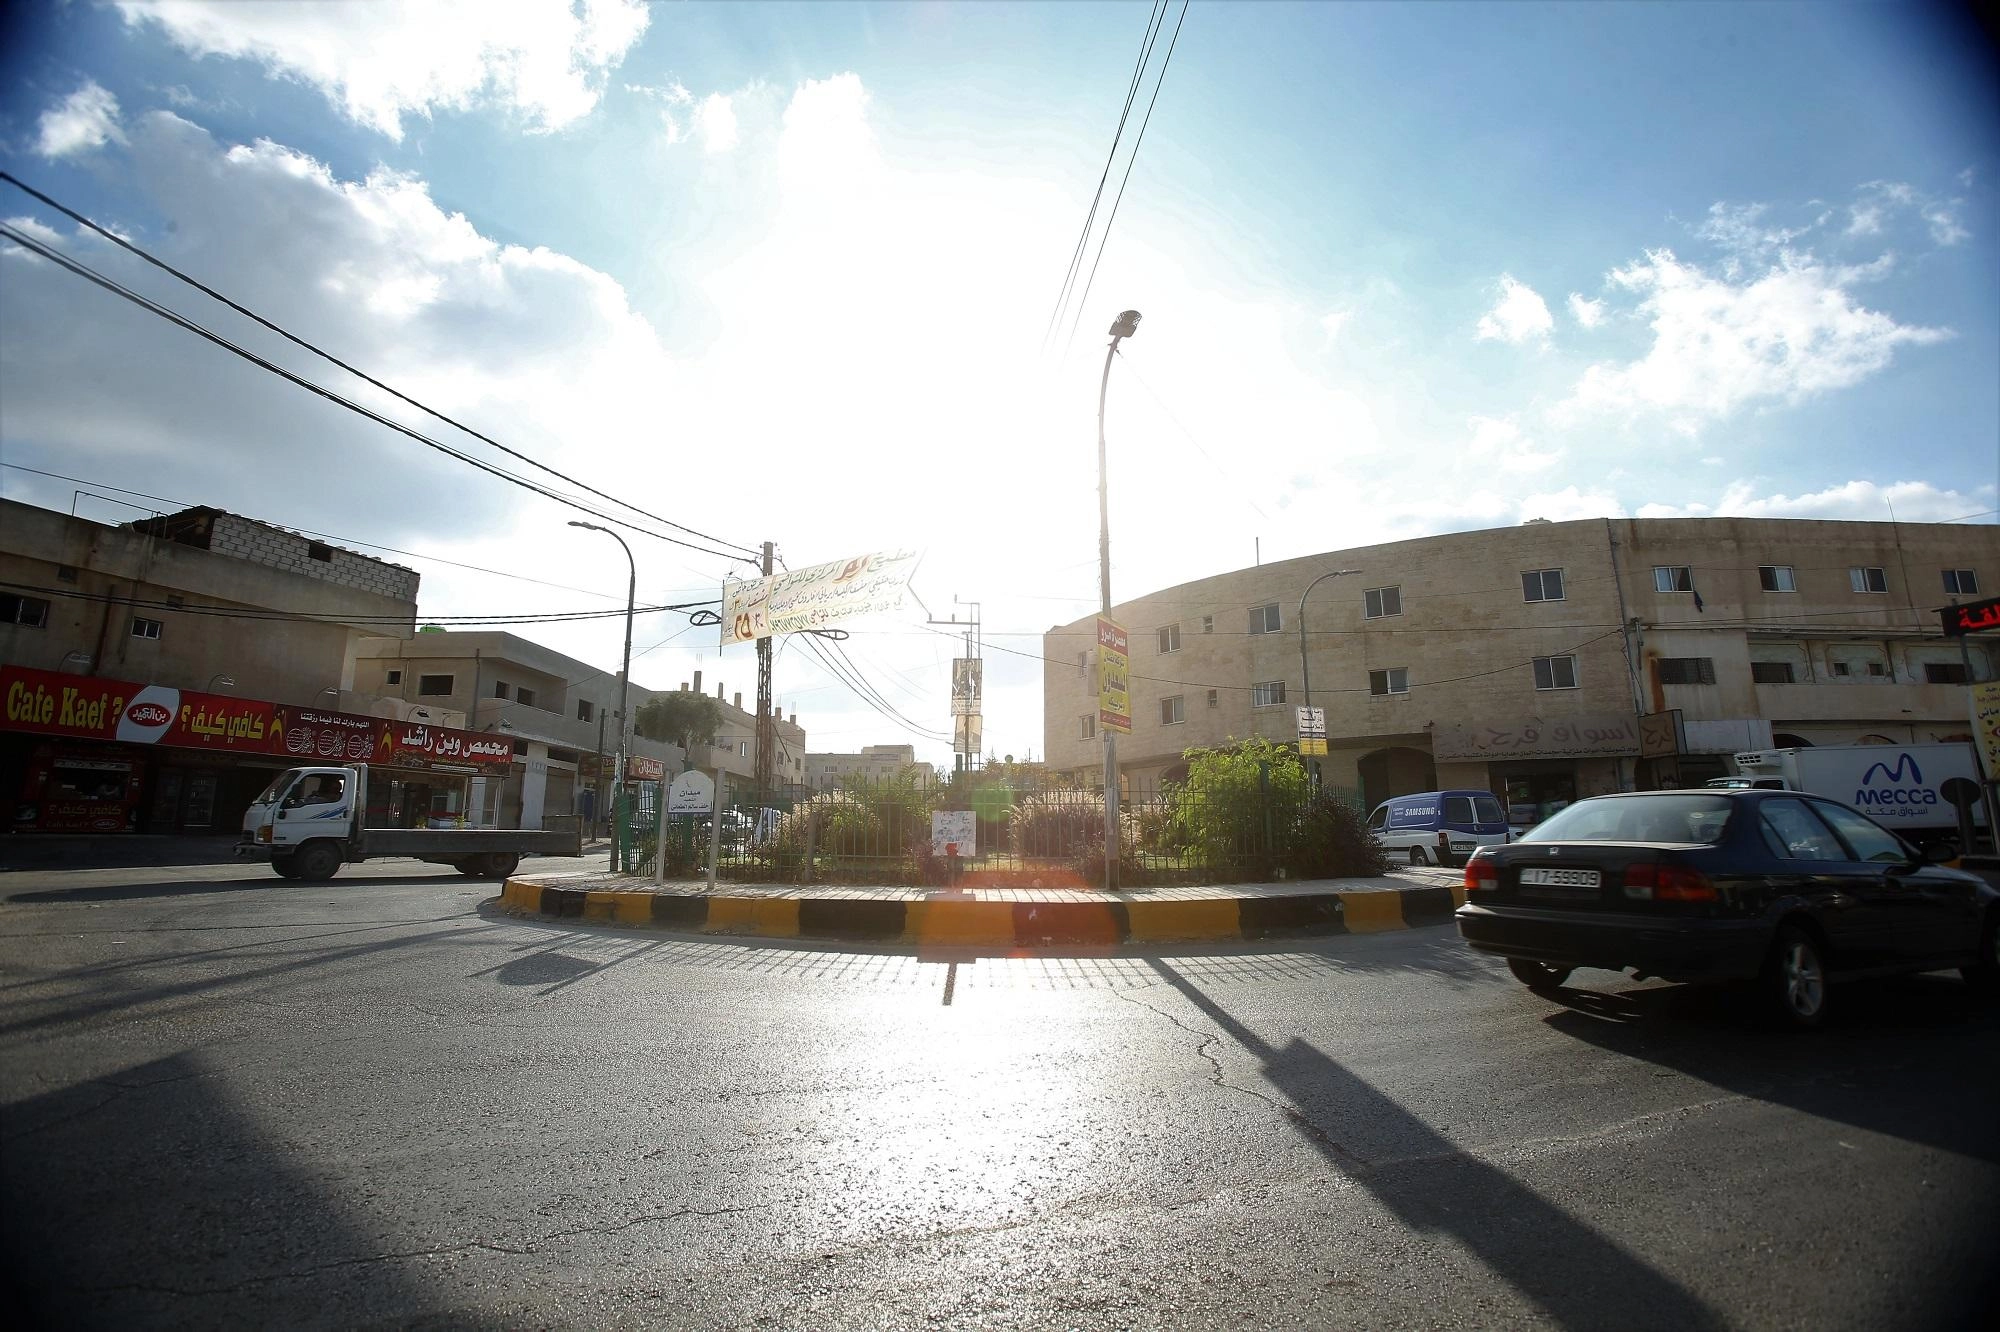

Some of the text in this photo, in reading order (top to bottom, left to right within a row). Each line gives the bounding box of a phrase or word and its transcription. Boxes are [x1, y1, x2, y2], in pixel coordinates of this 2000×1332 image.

[7, 680, 54, 725] Cafe
[58, 687, 109, 730] Kaef
[191, 704, 226, 742] كيف
[319, 715, 332, 725] فيما
[333, 717, 341, 725] لنا
[341, 719, 356, 728] بارك
[355, 721, 370, 729] اللهم
[227, 710, 265, 744] كافي
[401, 725, 434, 752] راشد
[462, 742, 509, 758] محمص
[1405, 806, 1435, 817] SAMSUNG
